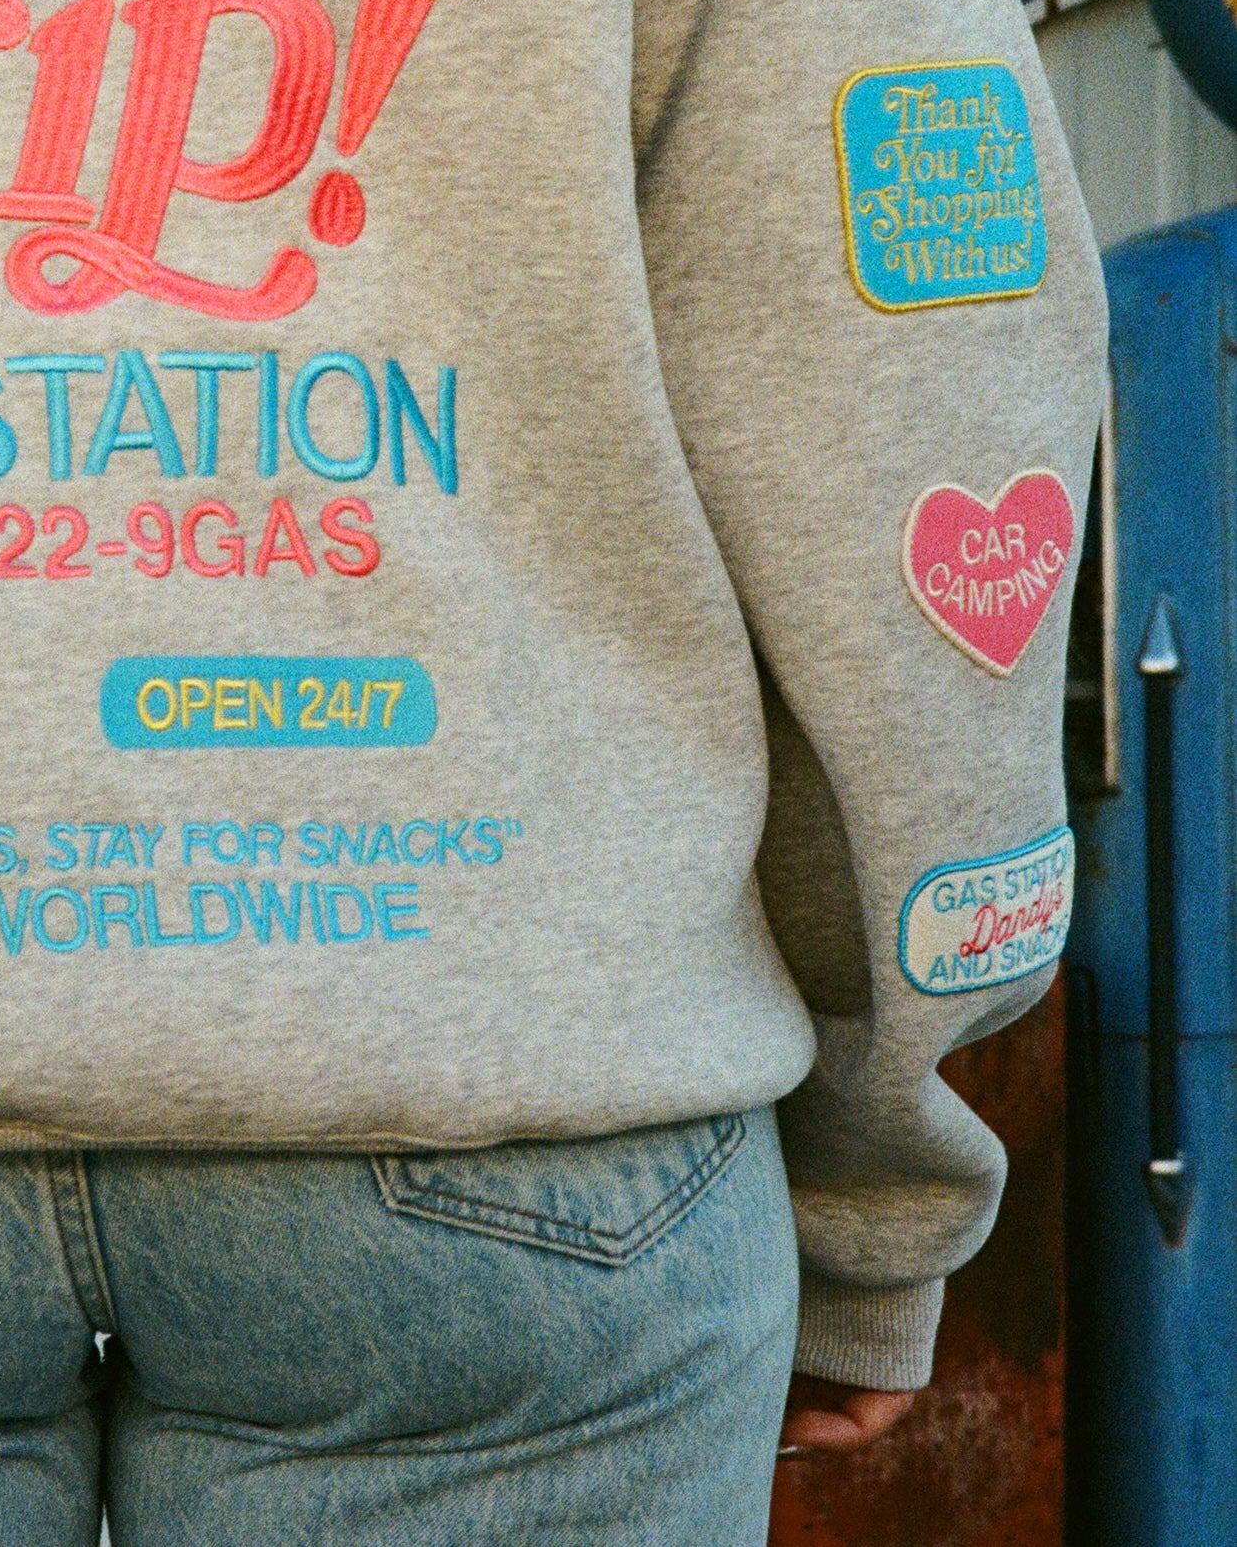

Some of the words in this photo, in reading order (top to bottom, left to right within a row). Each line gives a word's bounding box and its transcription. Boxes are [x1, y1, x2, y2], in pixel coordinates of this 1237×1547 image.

[883, 82, 1014, 138] Thank
[874, 137, 959, 184] You
[965, 130, 1024, 189] for
[856, 176, 1038, 242] Shopping
[961, 523, 1026, 565] CAR
[926, 540, 1065, 618] CAMPING
[136, 678, 282, 731] OPEN
[297, 678, 404, 731] 24/7
[45, 821, 164, 871] STAY
[180, 819, 285, 867] FOR
[297, 814, 525, 867] SNACKS"
[933, 875, 997, 913] GAS
[926, 951, 993, 986] AND
